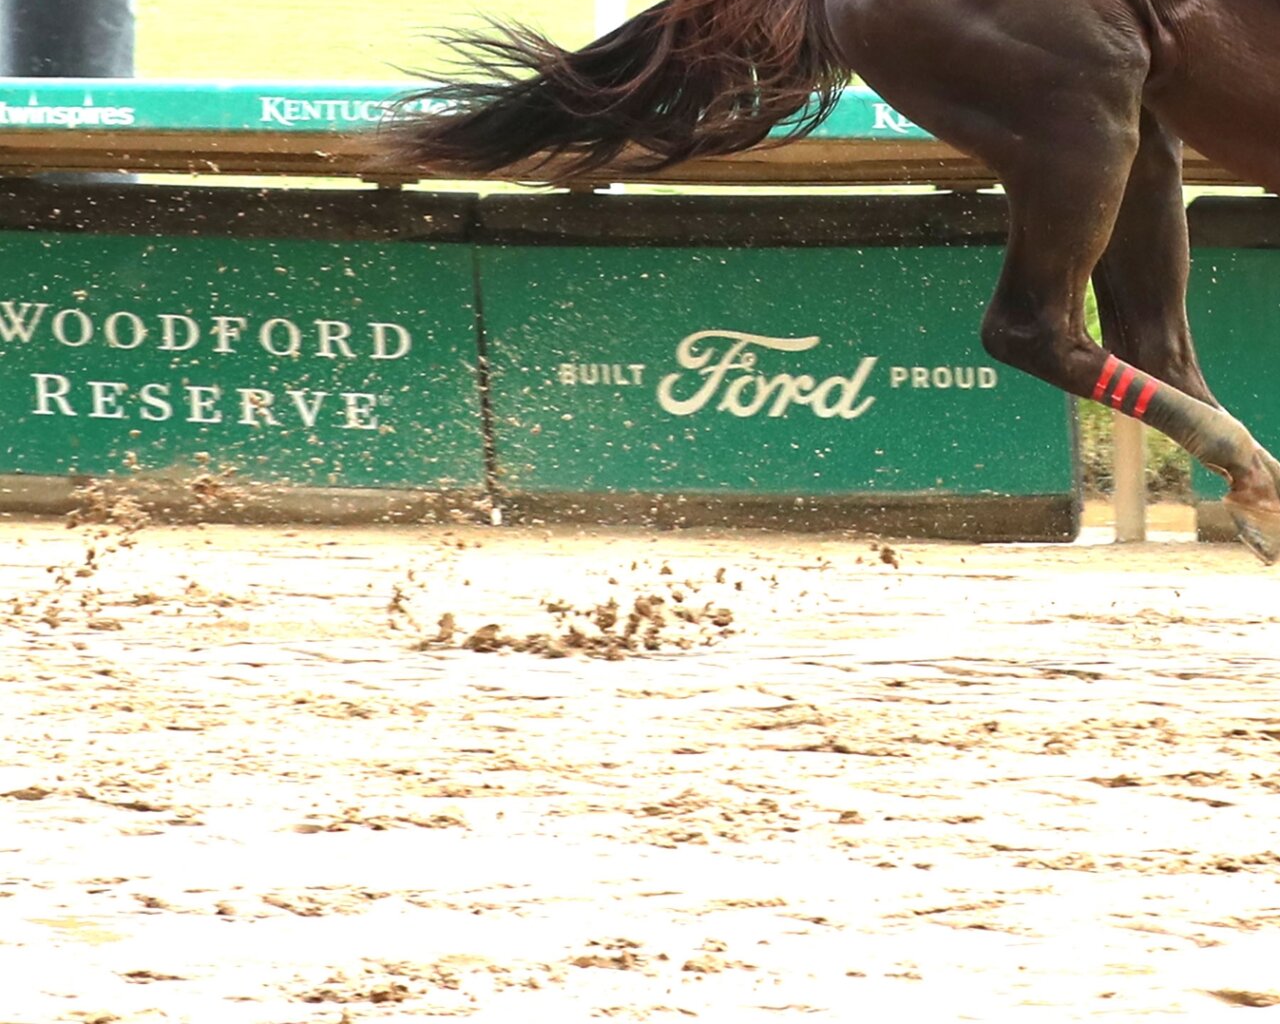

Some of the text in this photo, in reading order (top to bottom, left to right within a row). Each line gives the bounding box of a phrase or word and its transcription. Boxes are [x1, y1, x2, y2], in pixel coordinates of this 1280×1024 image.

[0, 301, 412, 360] WOODFORD
[31, 373, 379, 430] RESERVE
[559, 330, 998, 419] BUILT Ford PROUD
